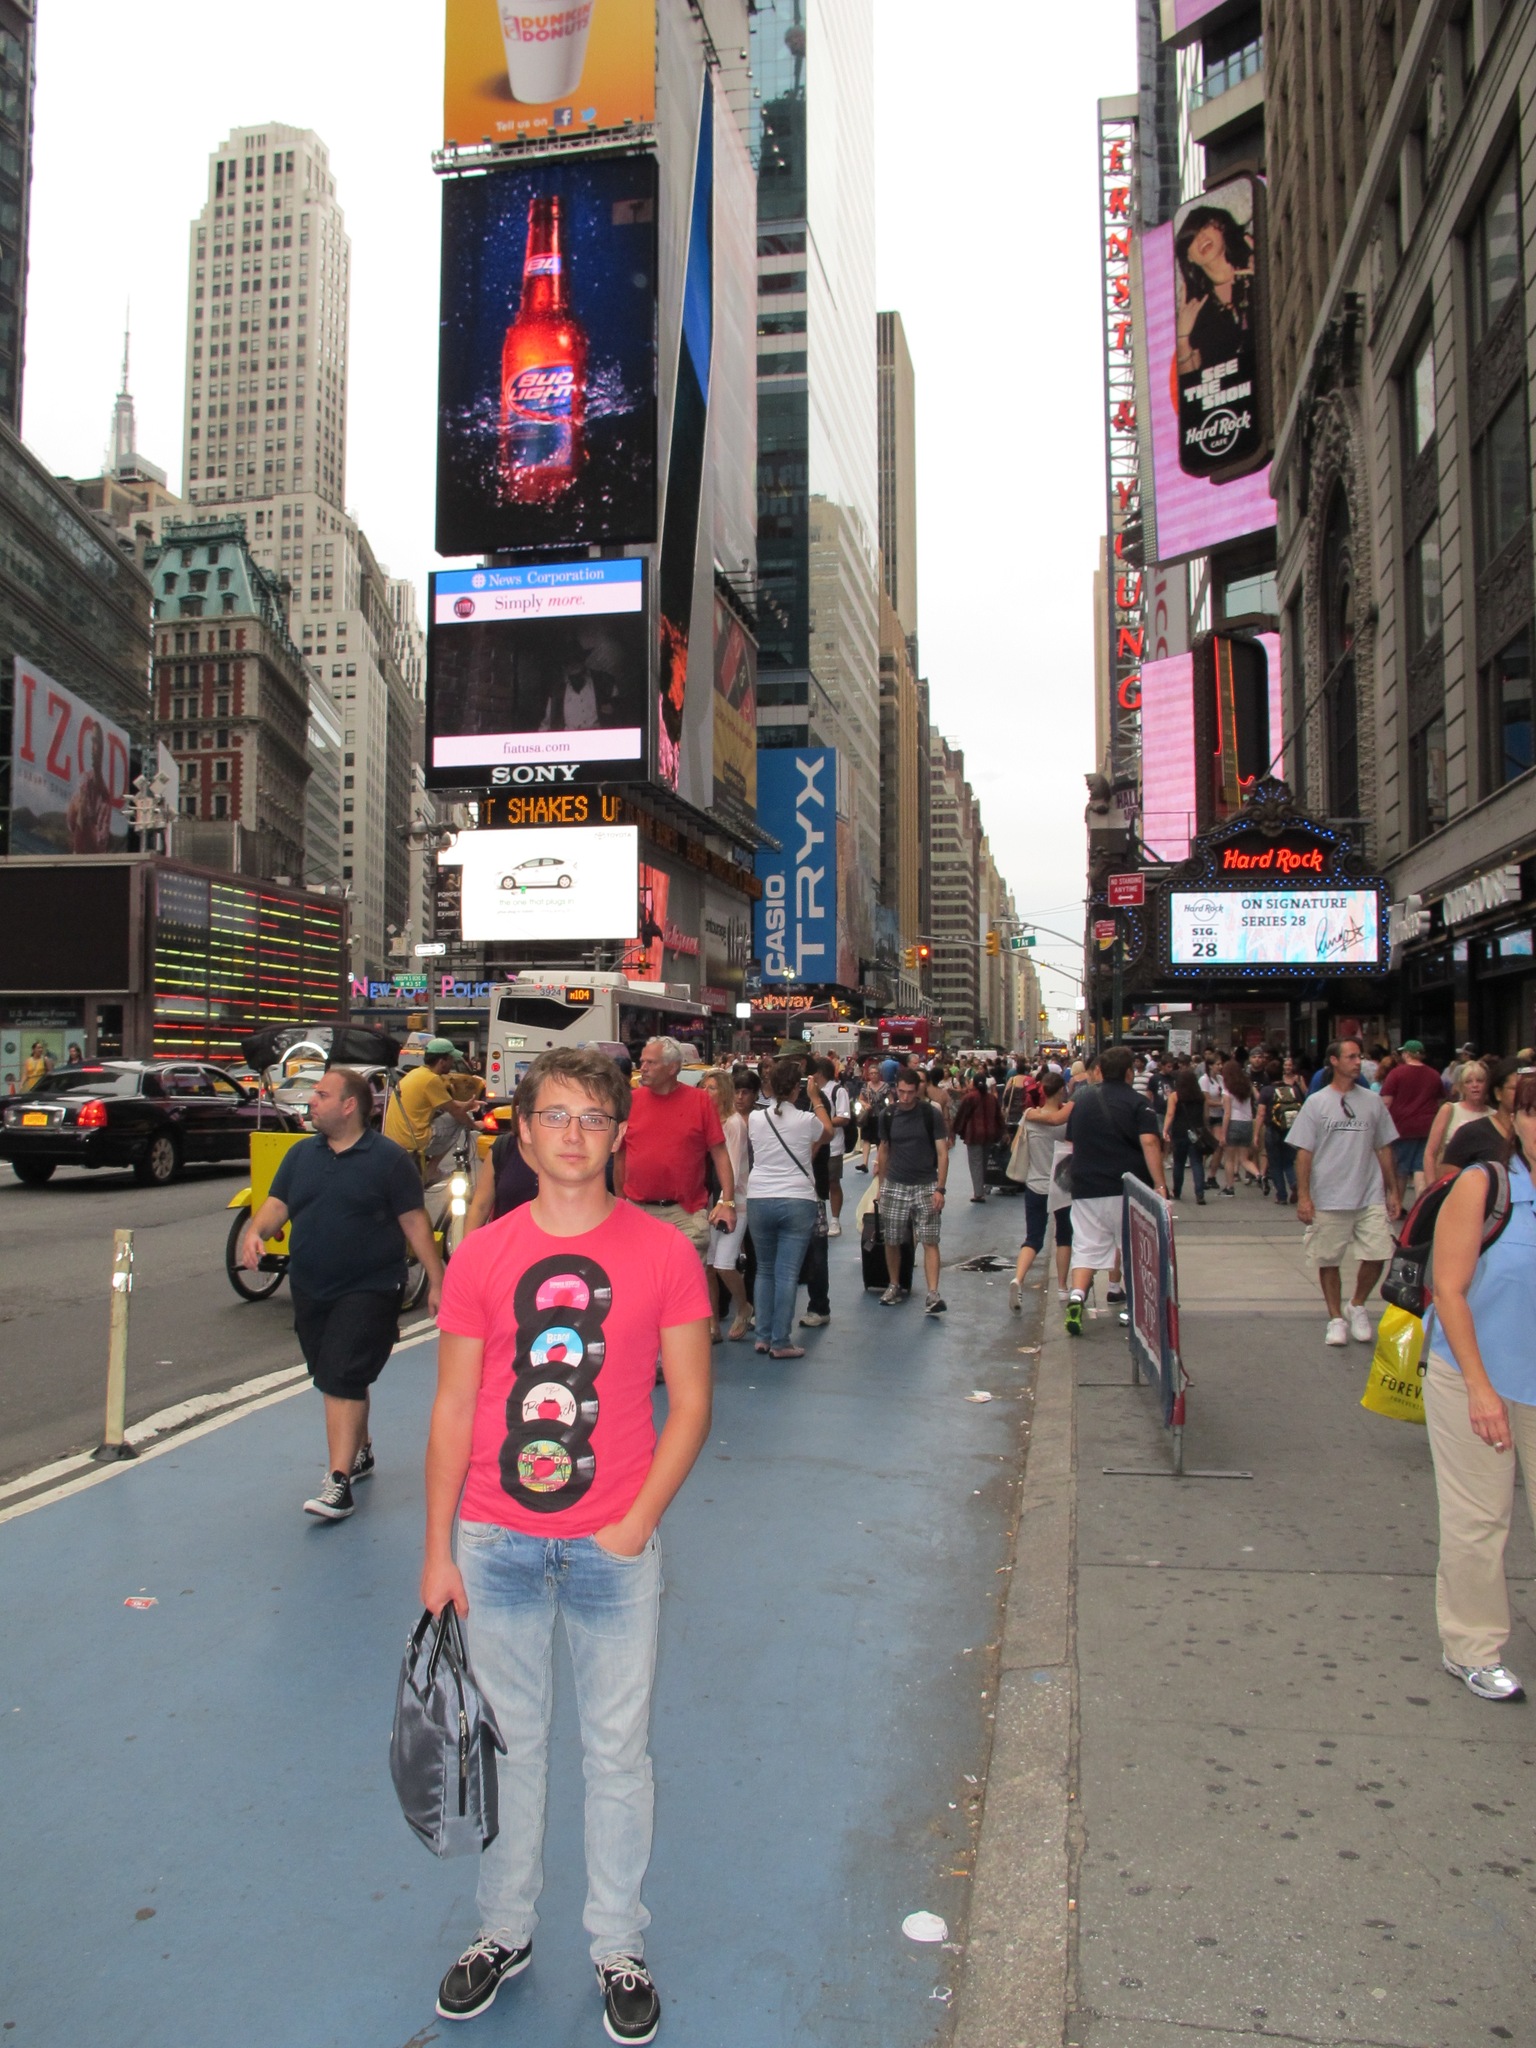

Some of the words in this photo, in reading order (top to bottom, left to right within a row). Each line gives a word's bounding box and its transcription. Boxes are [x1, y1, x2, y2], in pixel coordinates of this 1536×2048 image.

[496, 120, 515, 131] Tell
[517, 120, 530, 129] us
[533, 118, 548, 127] on
[1109, 140, 1132, 351] ERNST
[1201, 358, 1238, 384] SEE
[518, 371, 574, 388] BUD
[509, 385, 577, 401] LIGHT
[1183, 379, 1221, 403] THE
[1202, 381, 1252, 411] SHOW
[1186, 420, 1219, 445] Hard
[1219, 410, 1251, 436] Rock
[489, 573, 522, 587] News
[527, 568, 604, 585] Corporation
[495, 593, 543, 613] Simply
[547, 595, 585, 607] more.
[503, 742, 570, 754] fiatusa.com
[491, 764, 580, 785] SONY
[508, 796, 588, 824] SHAKES
[796, 756, 825, 976] TRYX
[1224, 849, 1274, 869] Hard
[1276, 848, 1324, 873] Rock
[1110, 878, 1118, 886] NO
[1119, 876, 1142, 885] STANDING
[1114, 885, 1138, 893] ANYTIME
[499, 898, 511, 906] the
[529, 898, 544, 906] that
[545, 898, 565, 907] plugs
[1184, 904, 1204, 913] Hard
[1205, 904, 1224, 914] Rock
[1241, 899, 1262, 910] ON
[1266, 898, 1347, 909] SIGNATURE
[765, 874, 786, 977] CASIO
[1241, 916, 1287, 927] SERIES
[1291, 916, 1306, 926] 28
[1192, 927, 1218, 936] SIG.
[1017, 939, 1021, 947] 7
[1192, 943, 1218, 957] 28
[540, 988, 561, 997] 3924
[1380, 1374, 1423, 1401] FOREV
[521, 1454, 570, 1464] FLDA
